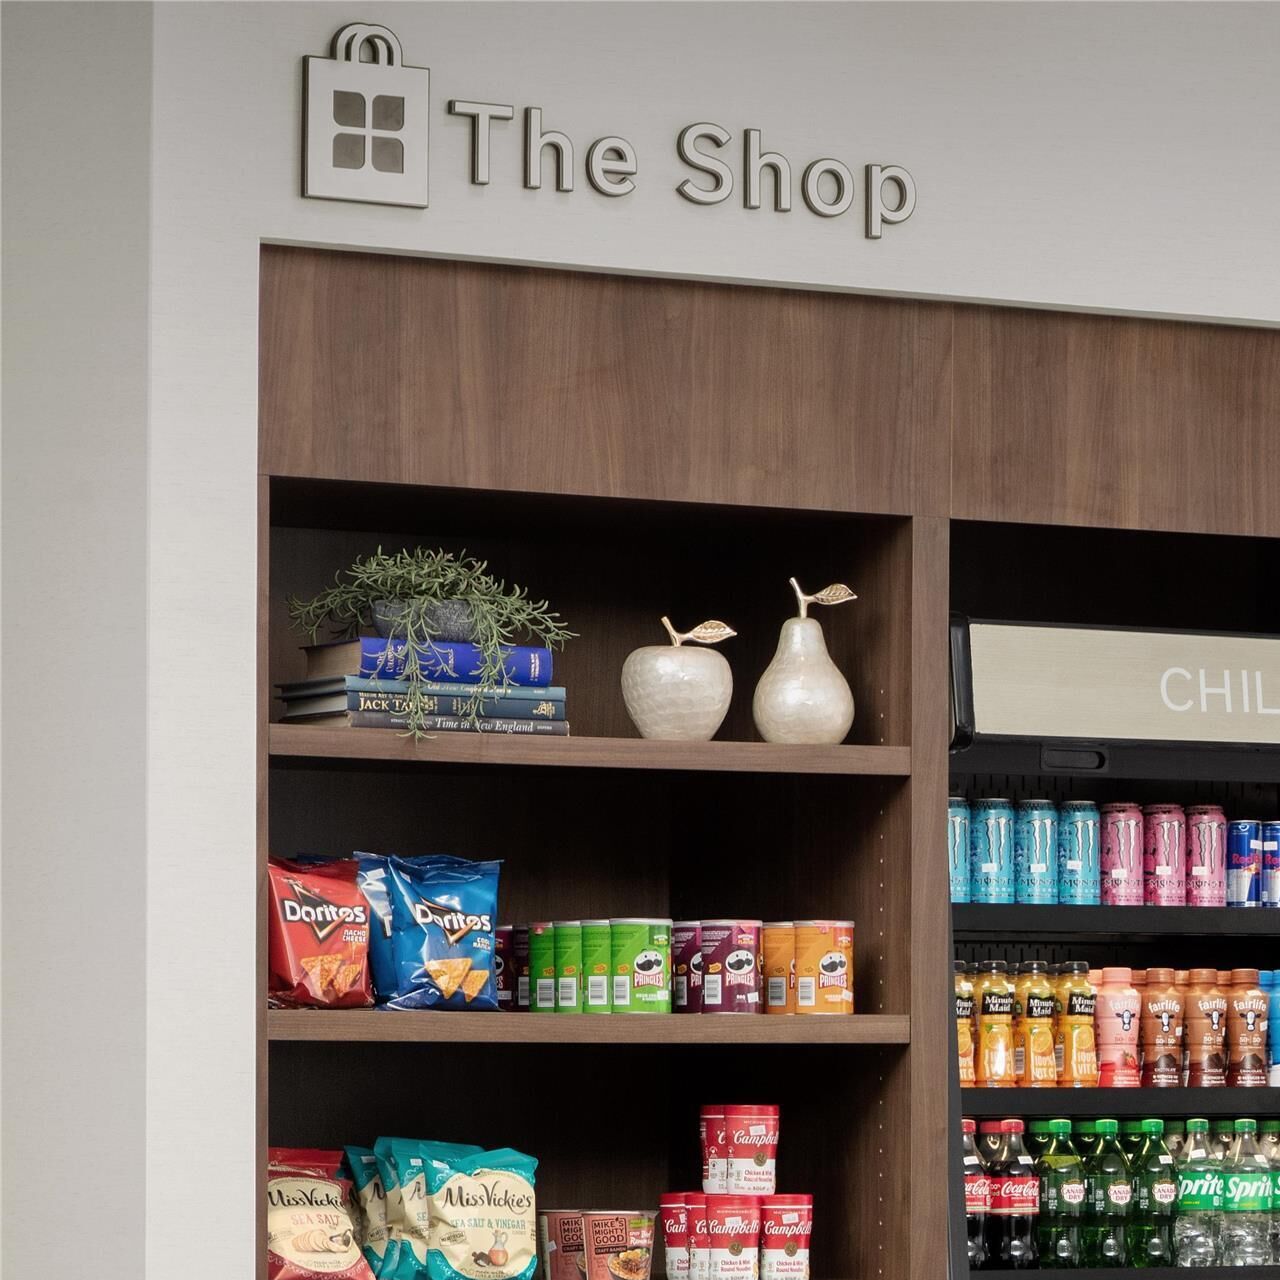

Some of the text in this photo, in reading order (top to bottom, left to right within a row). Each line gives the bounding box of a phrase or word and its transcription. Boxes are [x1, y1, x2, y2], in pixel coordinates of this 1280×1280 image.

[447, 98, 918, 240] The Shop
[358, 698, 389, 711] JACK
[435, 718, 533, 733] Time England
[284, 900, 369, 923] Doritos
[415, 903, 492, 932] Doritos
[342, 935, 367, 943] CHEESE
[634, 974, 664, 988] PRINGLES
[726, 974, 754, 986] PRINGLES
[819, 975, 847, 988] PRINGLES
[985, 996, 1014, 1005] Minute
[1029, 999, 1054, 1008] Minute
[1148, 1000, 1181, 1013] fairlife
[1233, 1000, 1267, 1012] fairlife
[988, 1004, 1011, 1013] Maid
[1032, 1007, 1052, 1016] Maid
[1075, 1004, 1095, 1014] Maid
[1180, 1173, 1224, 1196] prite
[442, 1180, 532, 1215] Miss Vickie's
[291, 1214, 340, 1226] SEA SALT
[467, 1220, 486, 1229] SALT
[495, 1218, 526, 1229] VINEGAR
[596, 1235, 624, 1244] GOOD
